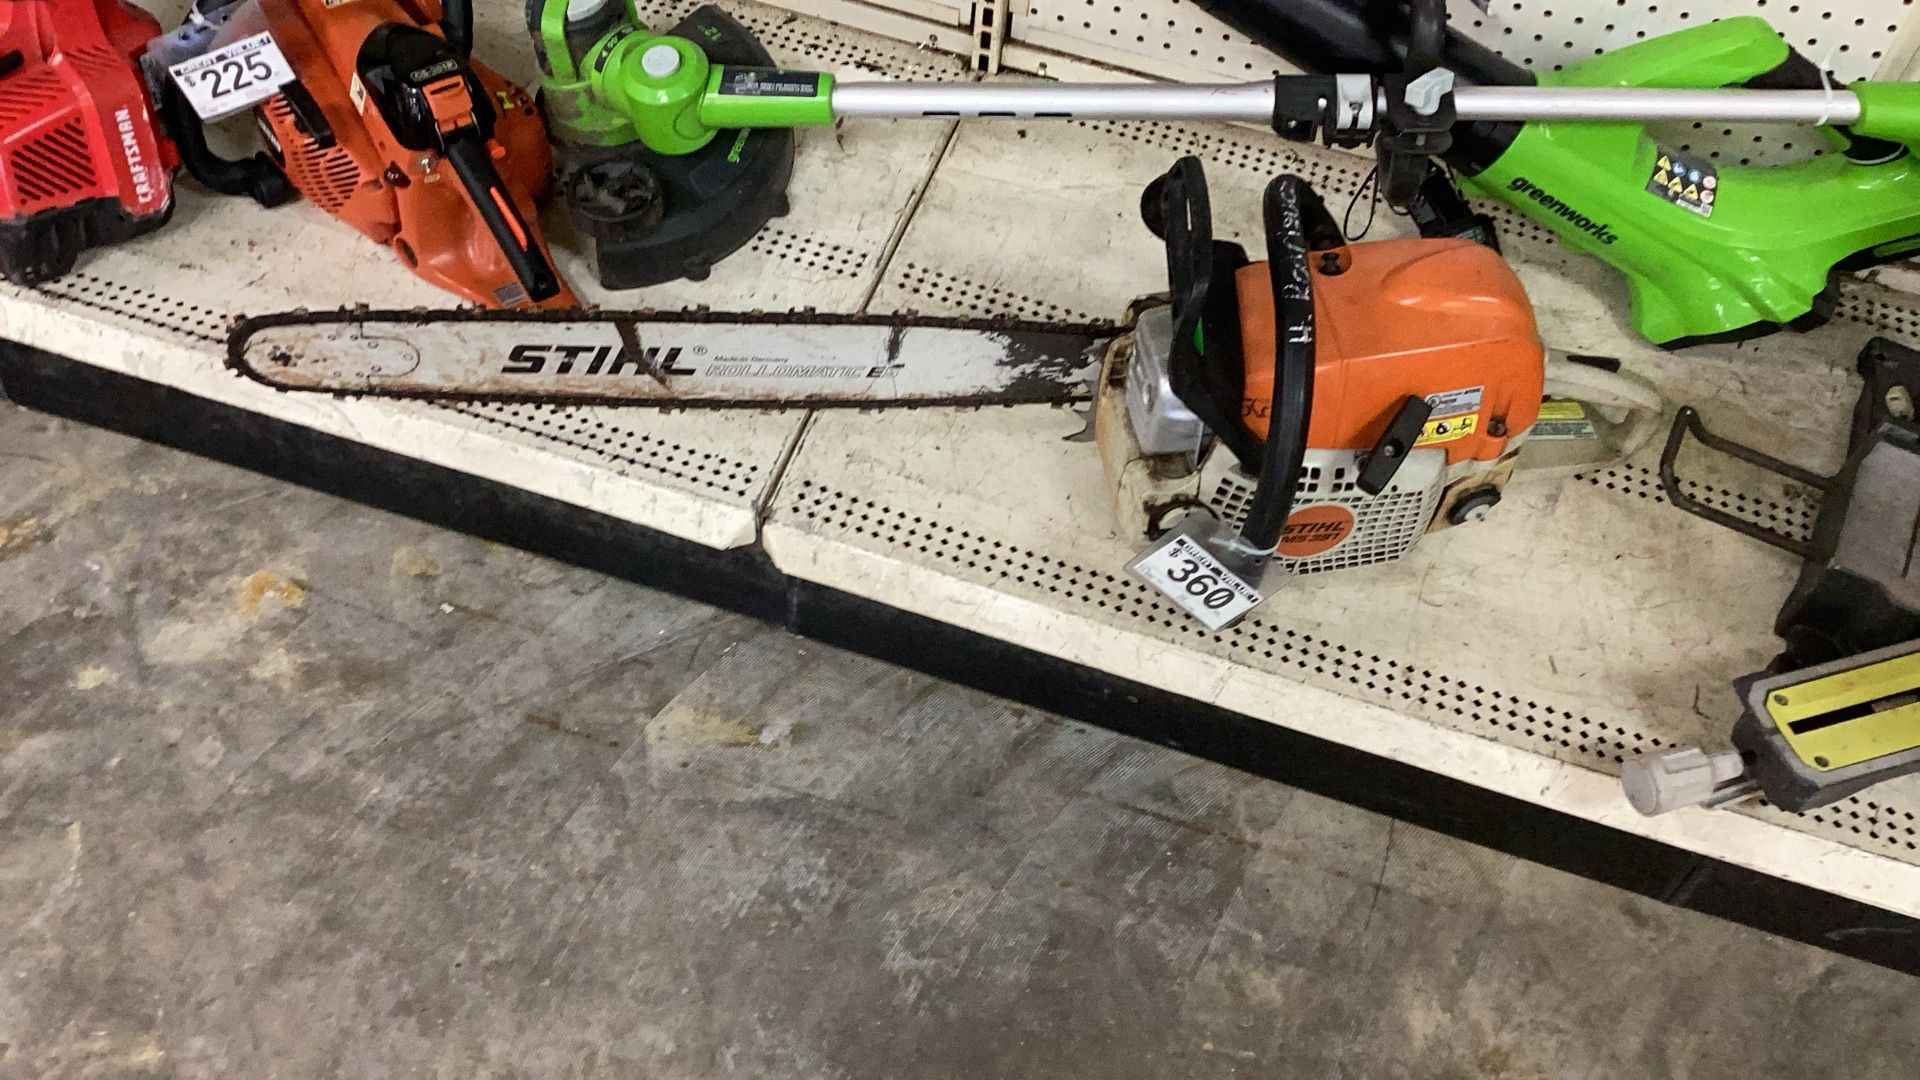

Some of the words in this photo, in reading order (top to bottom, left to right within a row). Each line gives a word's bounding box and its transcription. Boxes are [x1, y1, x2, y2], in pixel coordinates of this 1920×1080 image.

[200, 51, 272, 98] 225
[115, 108, 153, 203] CRAFTSMAN
[1506, 176, 1618, 245] greenworks
[501, 344, 697, 376] STIHL
[705, 364, 866, 378] ROLLOMATIC
[1280, 521, 1345, 535] STIHL
[1167, 559, 1235, 609] 360
